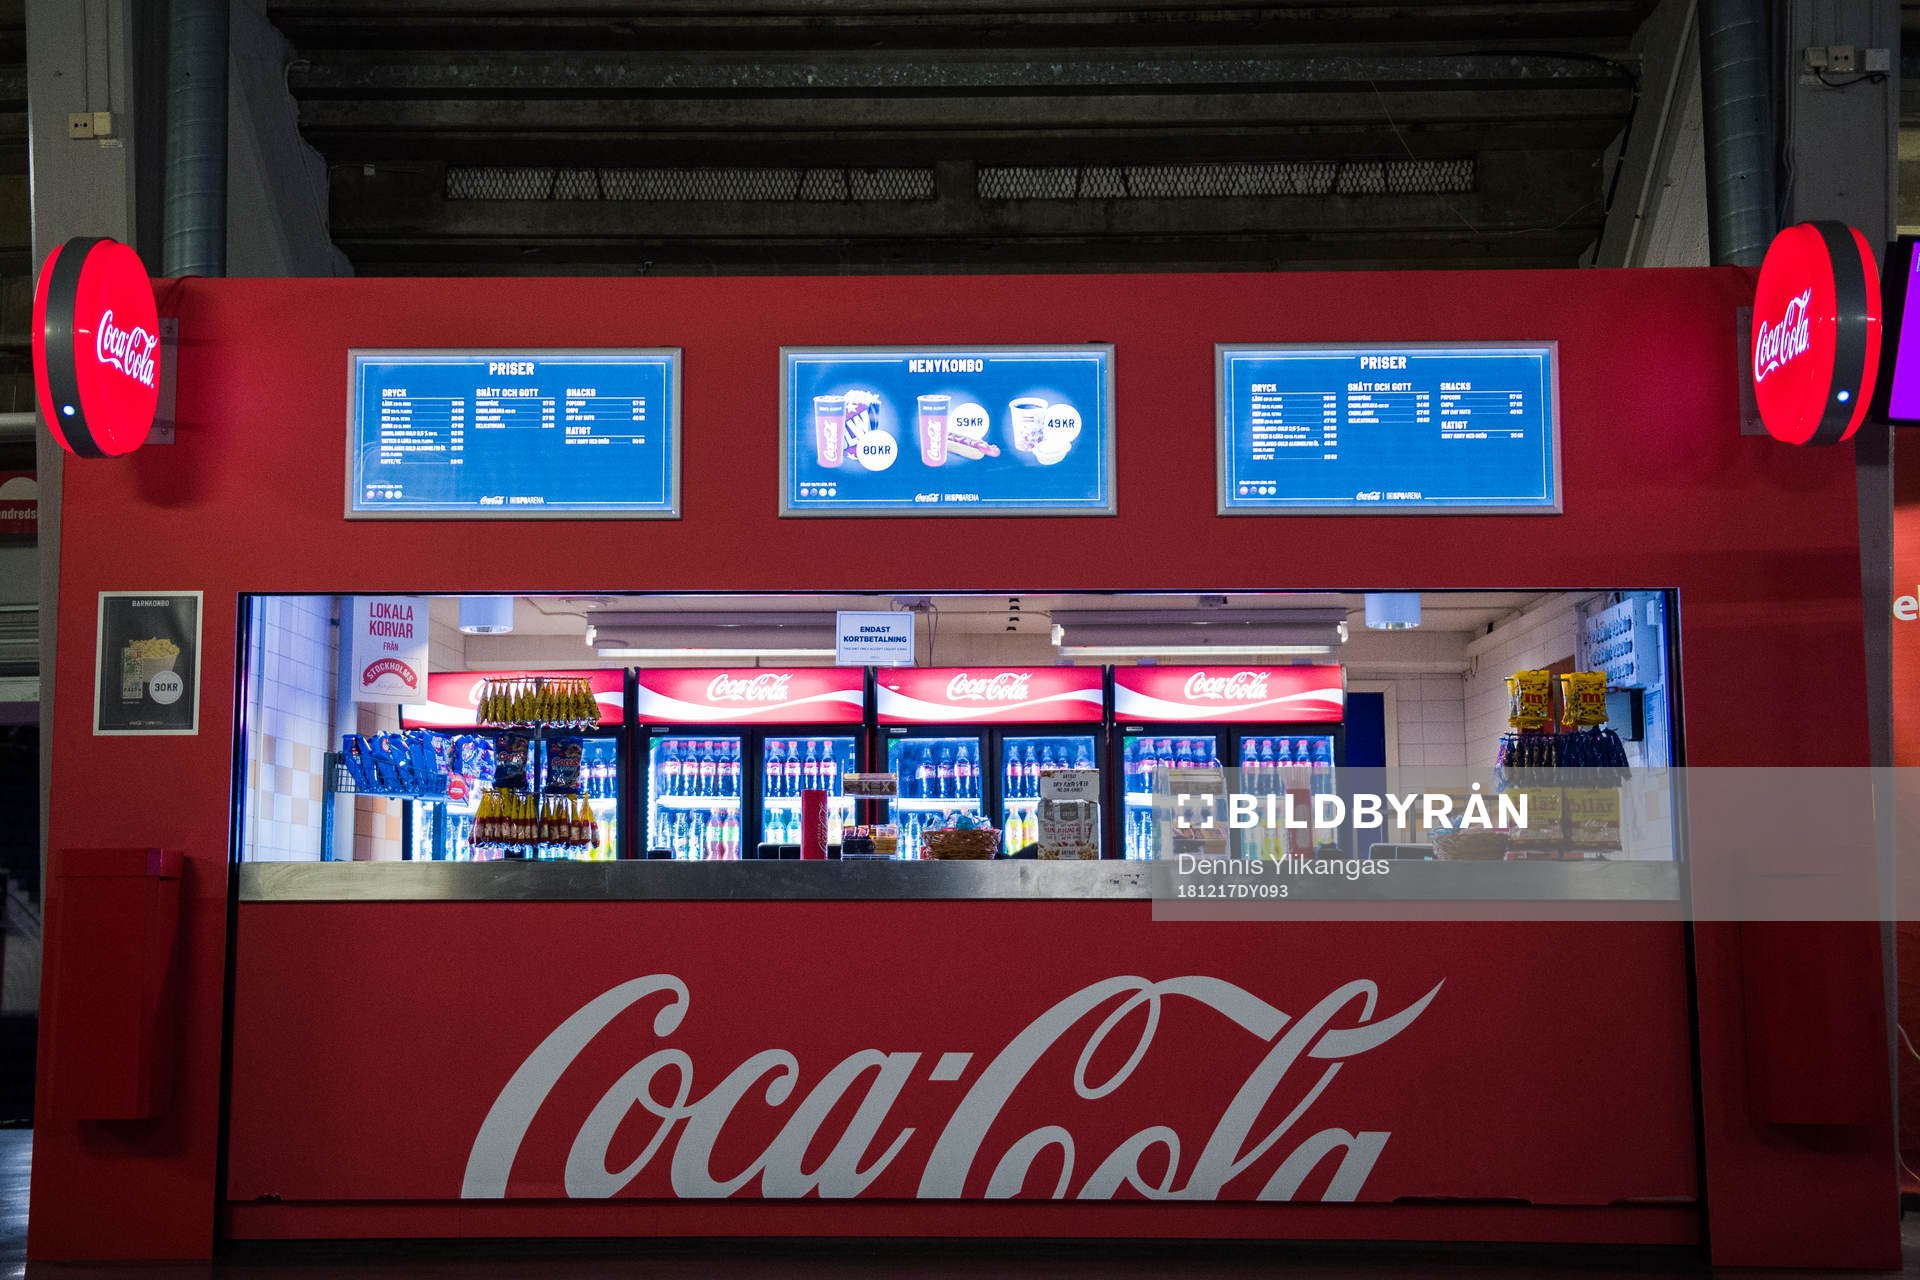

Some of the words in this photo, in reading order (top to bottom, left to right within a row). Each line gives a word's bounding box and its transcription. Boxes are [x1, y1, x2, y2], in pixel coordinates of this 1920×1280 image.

[1755, 287, 1811, 382] Coca-Cola
[96, 309, 157, 388] Coca-Cola
[489, 362, 534, 375] PRISER
[909, 359, 983, 372] MENYKOMBO
[1360, 356, 1406, 370] PRISER
[566, 388, 596, 397] SNACKS
[1252, 384, 1277, 393] DRYCK
[1392, 383, 1412, 391] GOTT
[1440, 382, 1471, 390] SNACKS
[382, 388, 407, 398] DRYCK
[502, 389, 518, 397] OCH
[519, 389, 538, 397] GOTT
[0, 508, 36, 520] ndreds
[369, 601, 414, 621] LOKALA
[369, 620, 413, 639] KORVAR
[383, 640, 399, 651] FRÅN
[366, 661, 416, 683] STOCKHOLMS
[707, 672, 792, 701] Coca-Cola
[946, 672, 1032, 701] Coca-Cola
[1184, 671, 1271, 700] Coca-Cola
[460, 973, 1446, 1201] Coca-Cola
